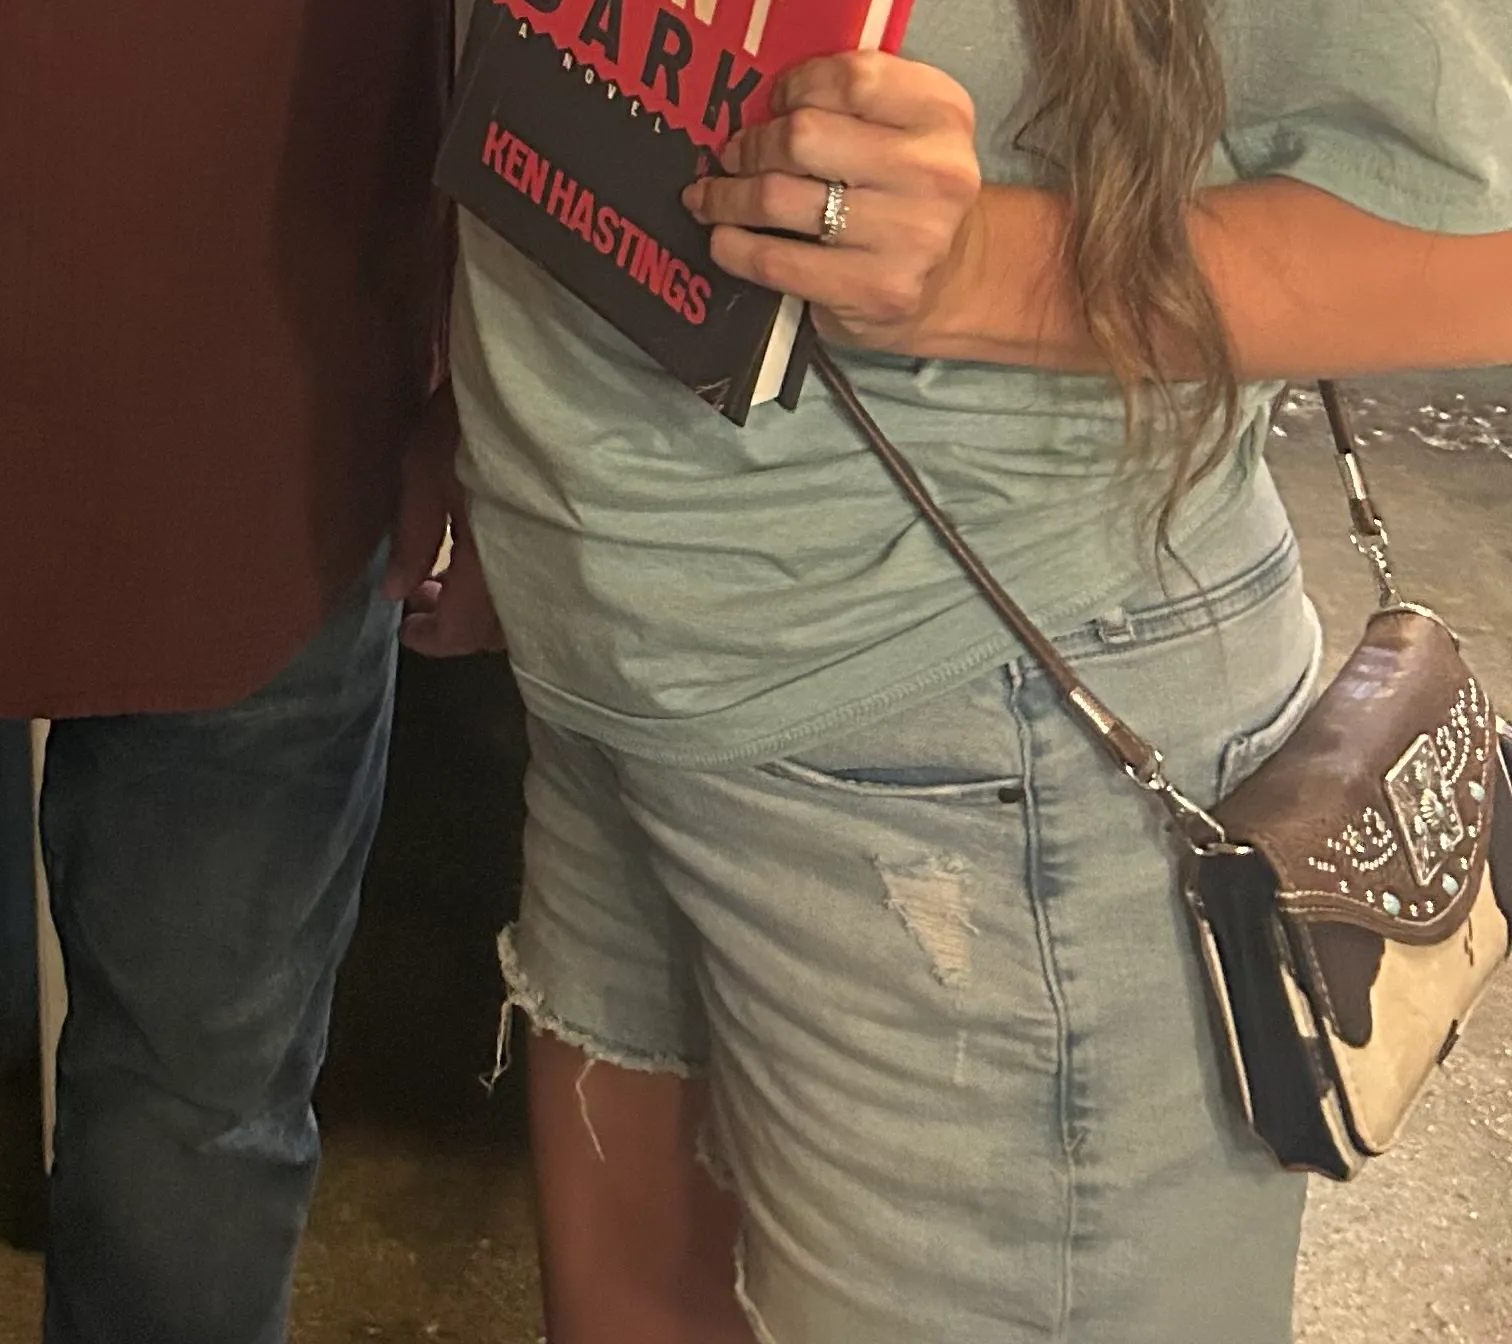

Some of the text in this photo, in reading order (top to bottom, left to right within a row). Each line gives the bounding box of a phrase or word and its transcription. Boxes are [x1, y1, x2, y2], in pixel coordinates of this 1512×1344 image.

[517, 21, 662, 134] A NOVEL
[482, 121, 712, 325] KEN HASTINGS
